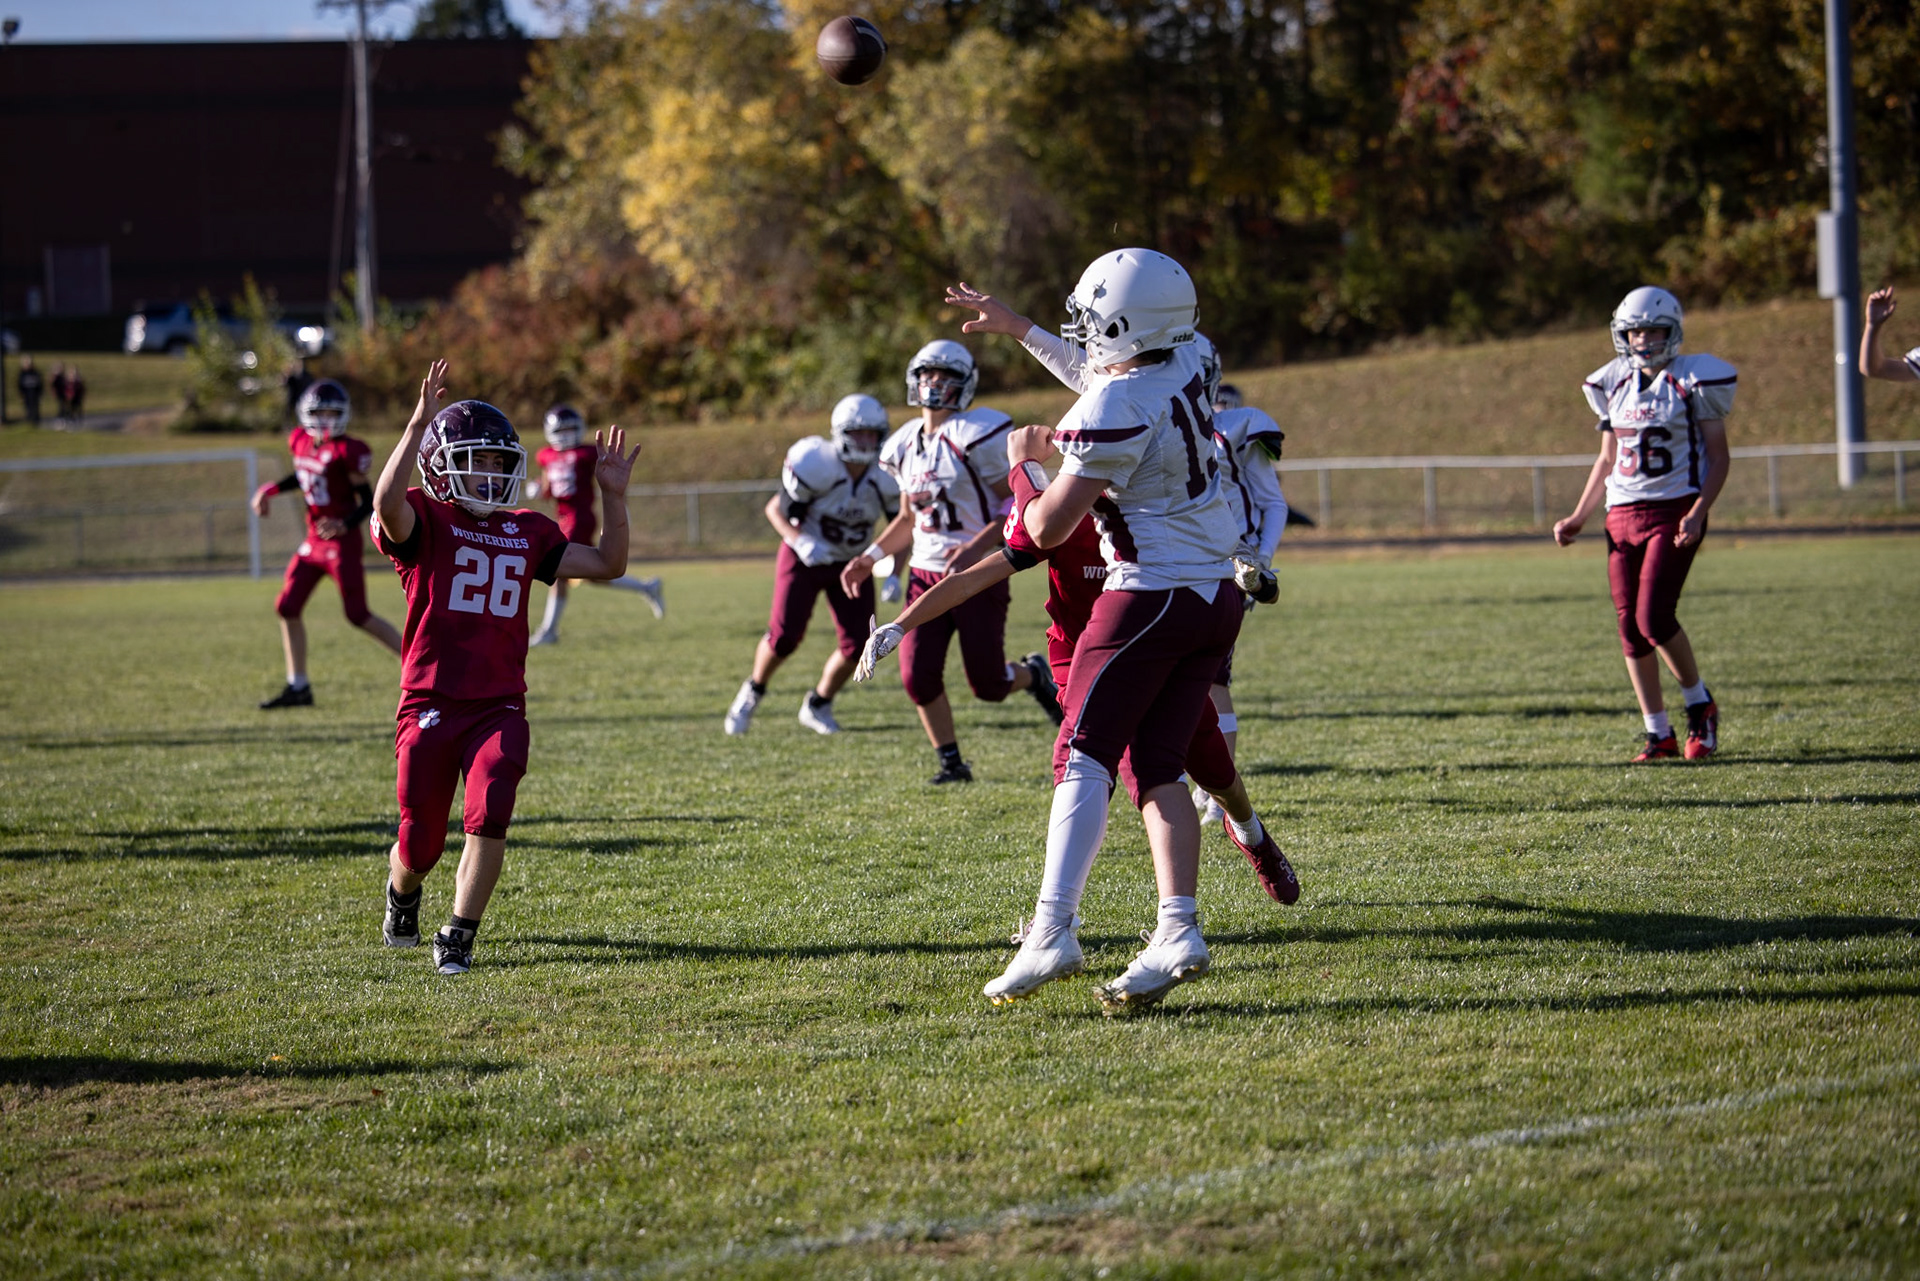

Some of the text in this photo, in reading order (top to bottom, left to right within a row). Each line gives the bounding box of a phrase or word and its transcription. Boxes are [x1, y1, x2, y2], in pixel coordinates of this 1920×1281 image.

[1613, 426, 1673, 478] 56
[450, 523, 530, 550] WOLVERINES
[447, 545, 527, 619] 26
[1083, 565, 1110, 580] WO
